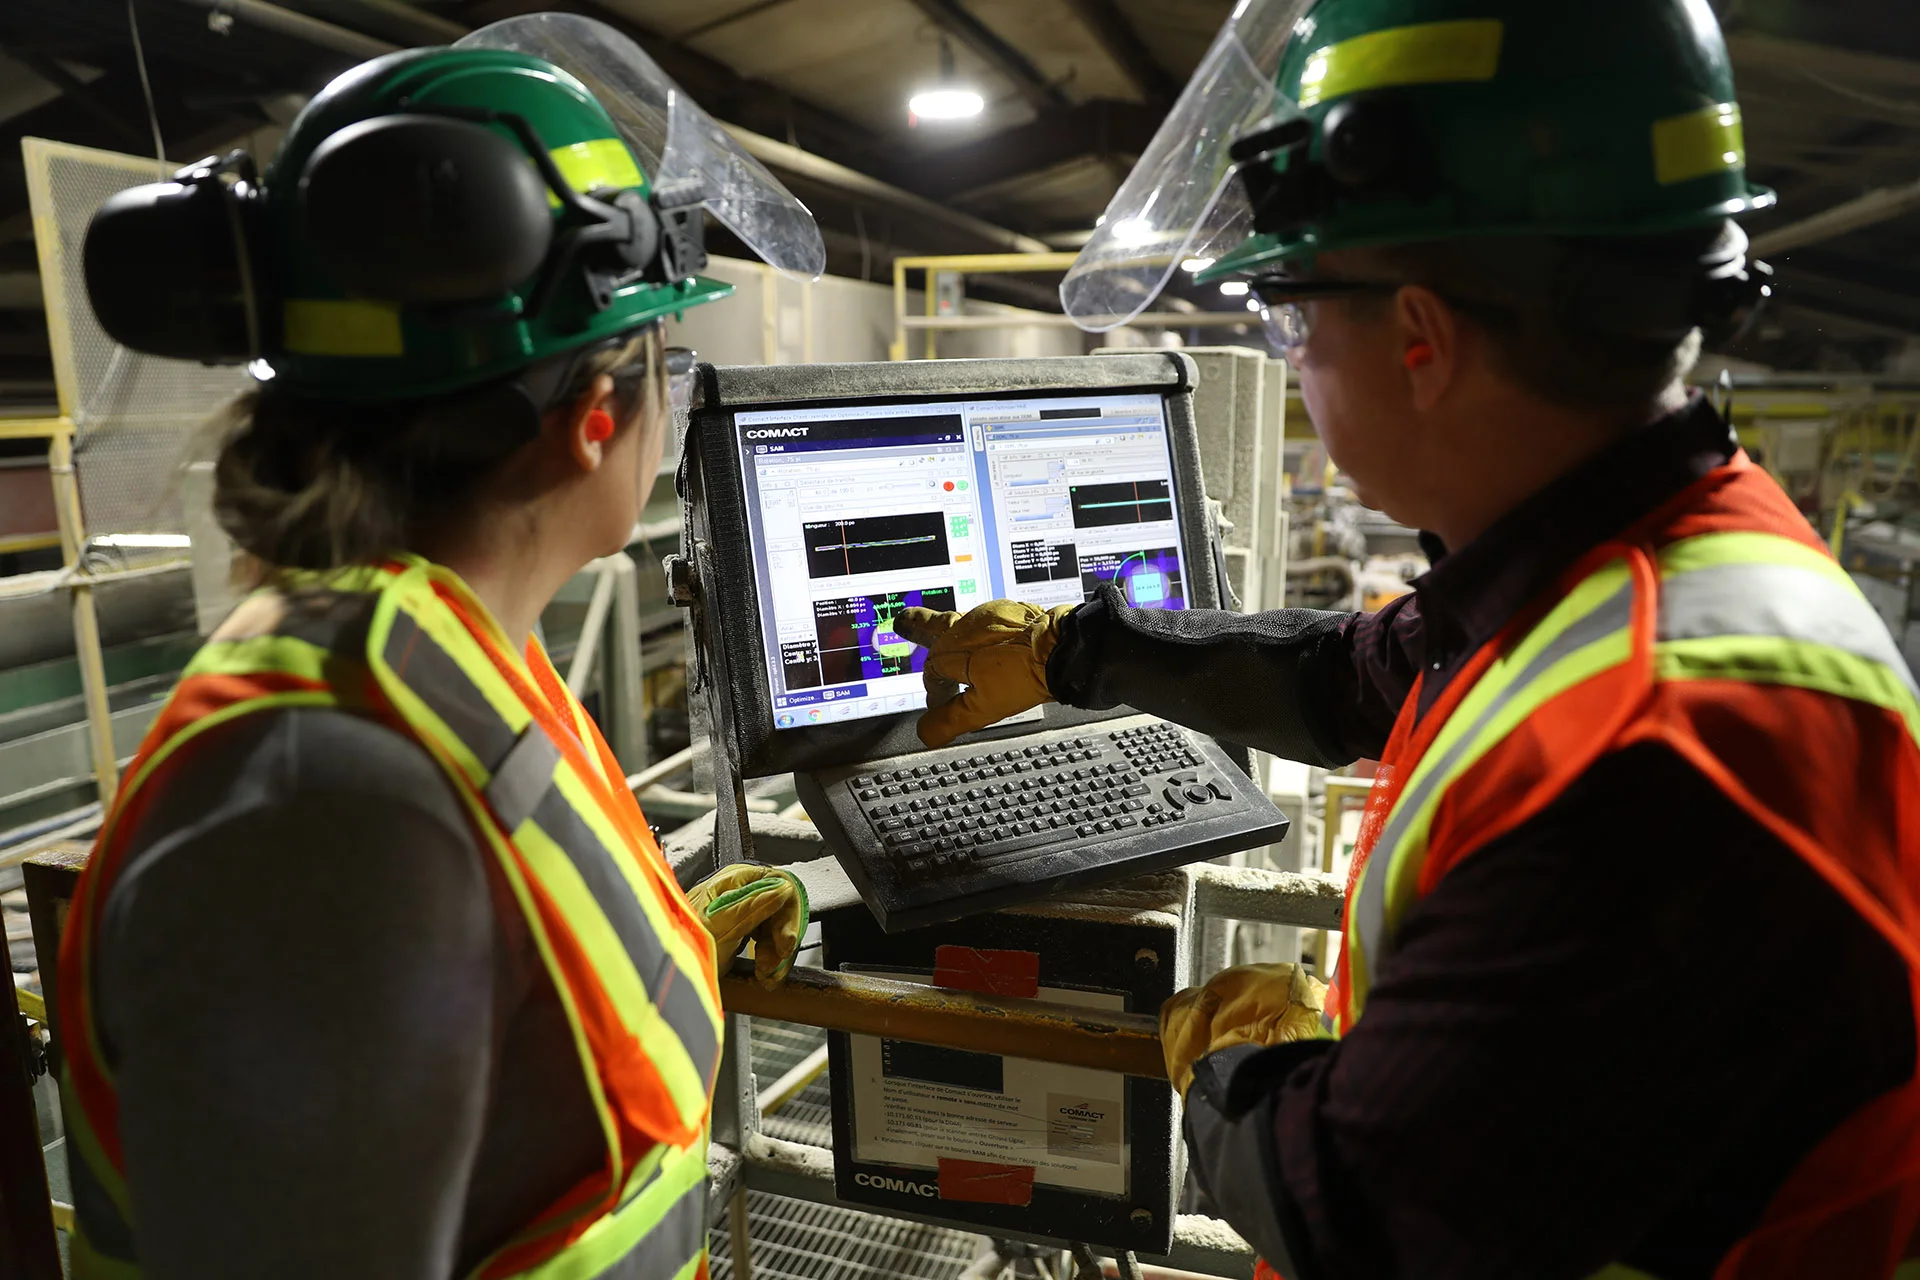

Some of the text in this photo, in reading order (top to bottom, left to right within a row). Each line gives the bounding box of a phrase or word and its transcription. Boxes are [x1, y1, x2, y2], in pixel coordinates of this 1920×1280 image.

[747, 428, 809, 438] COMACT
[783, 641, 810, 650] Diamètre
[1060, 1107, 1105, 1120] COMACT
[979, 1141, 1008, 1150] Ouverture
